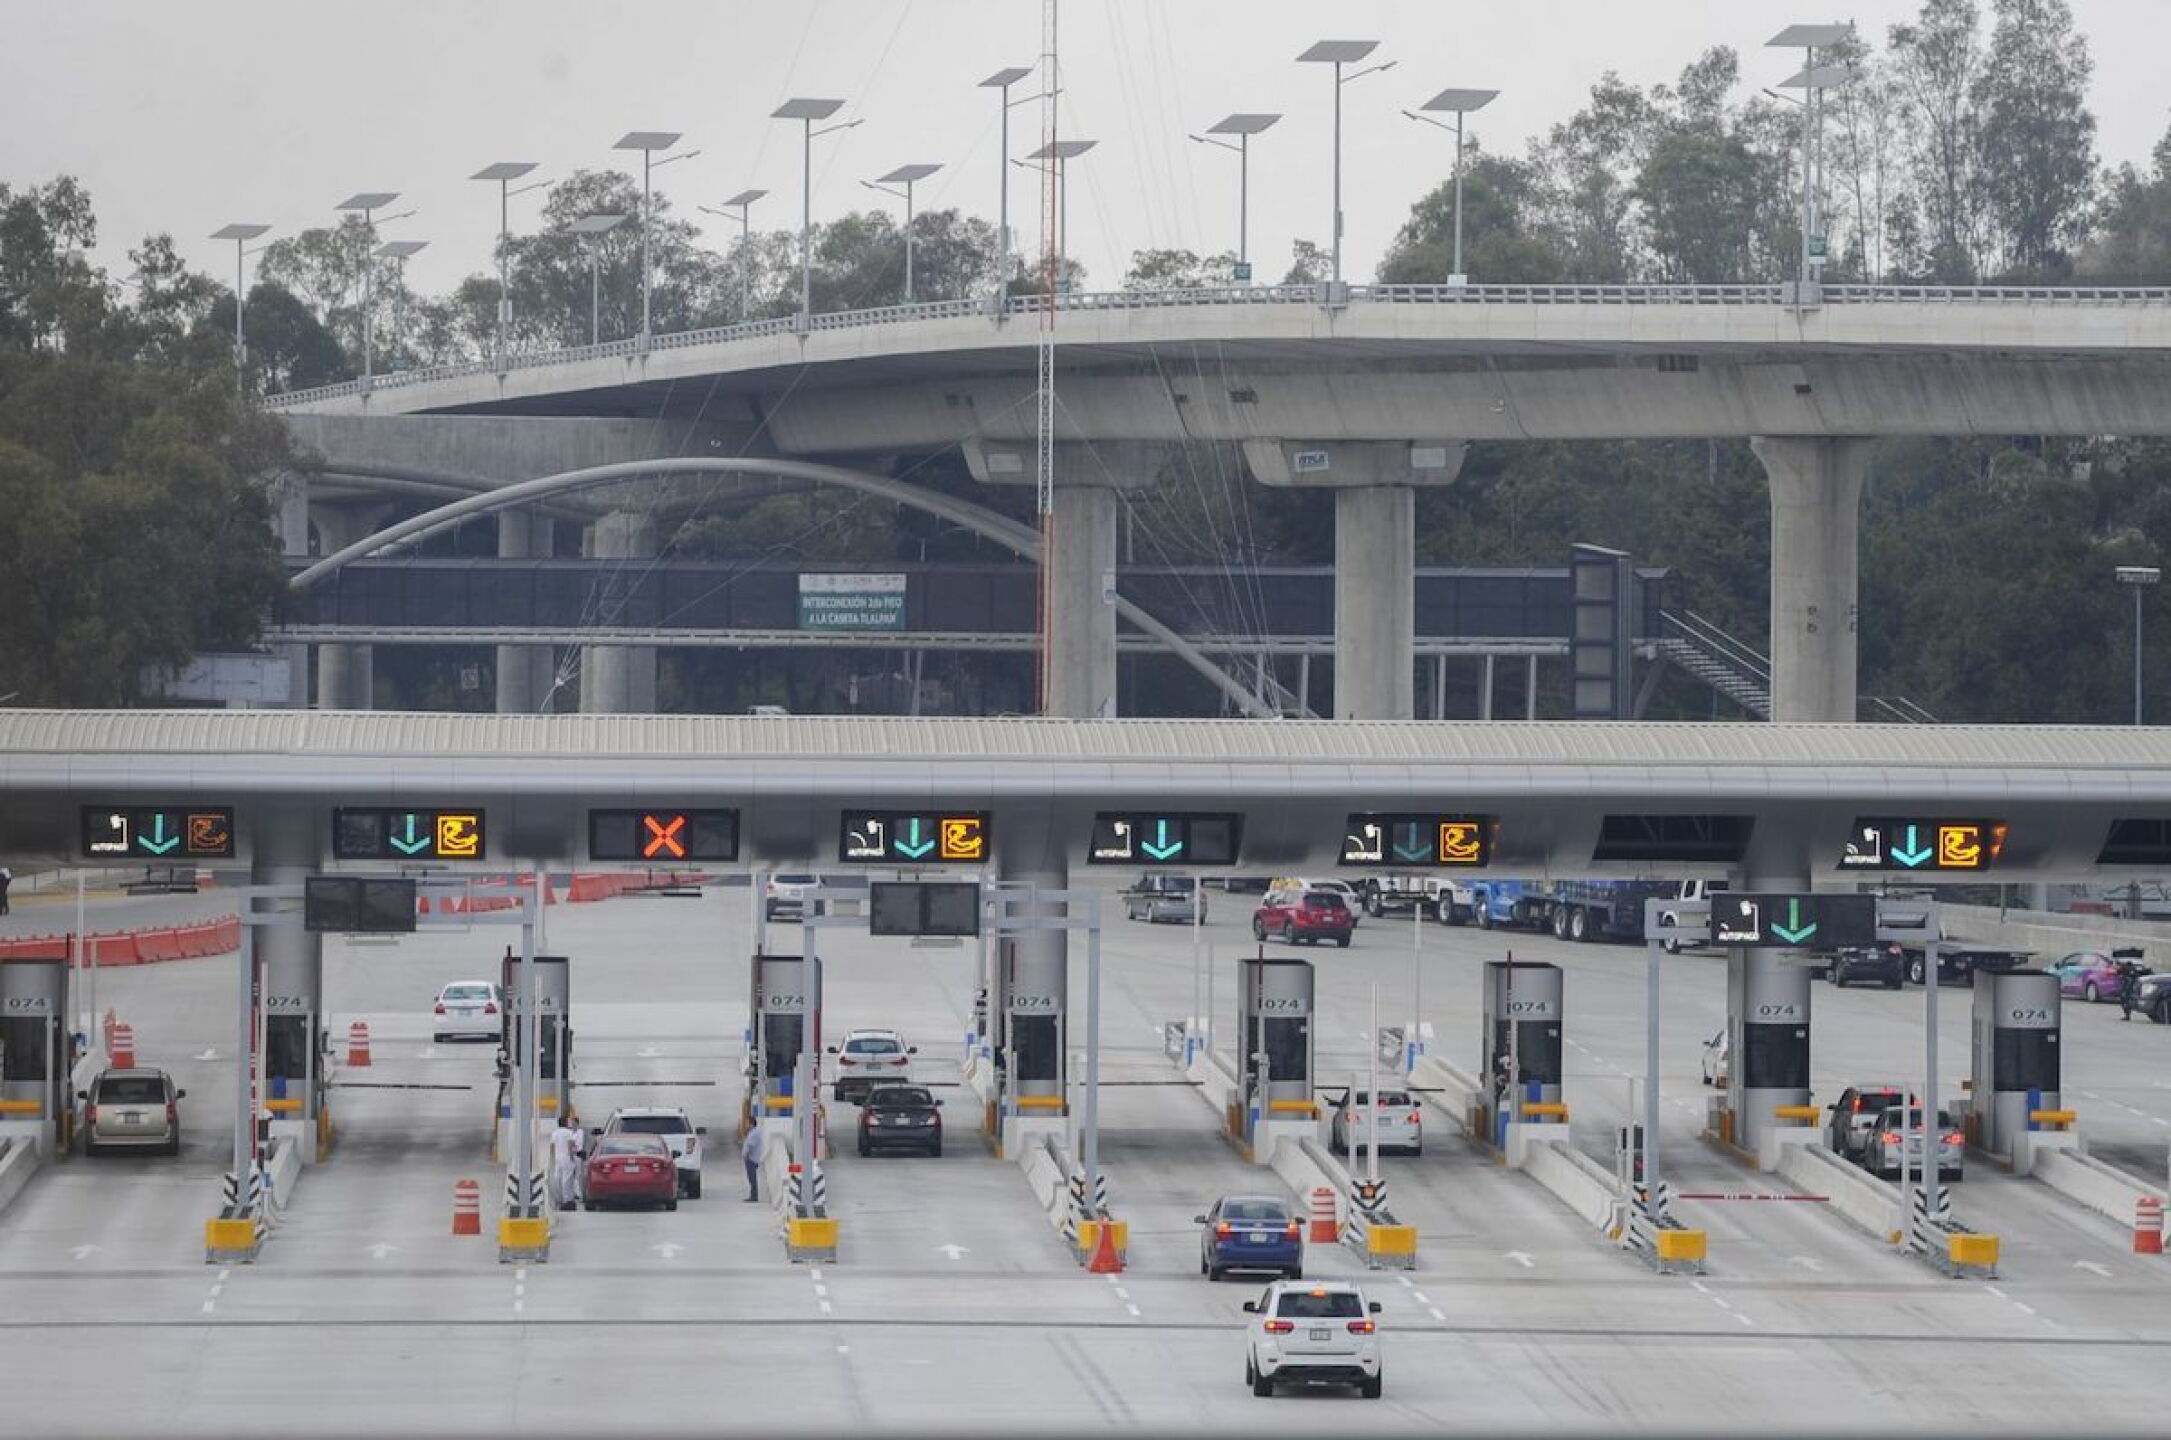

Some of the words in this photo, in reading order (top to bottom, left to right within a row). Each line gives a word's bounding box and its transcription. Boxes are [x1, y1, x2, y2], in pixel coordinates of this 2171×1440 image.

[8, 998, 46, 1009] 074
[267, 996, 301, 1007] 074
[772, 995, 804, 1006] 074
[1017, 996, 1051, 1007] 074
[1265, 998, 1298, 1009] 074
[1512, 1001, 1546, 1012] 074
[1760, 1005, 1795, 1016] 074
[2012, 1008, 2047, 1020] 074
